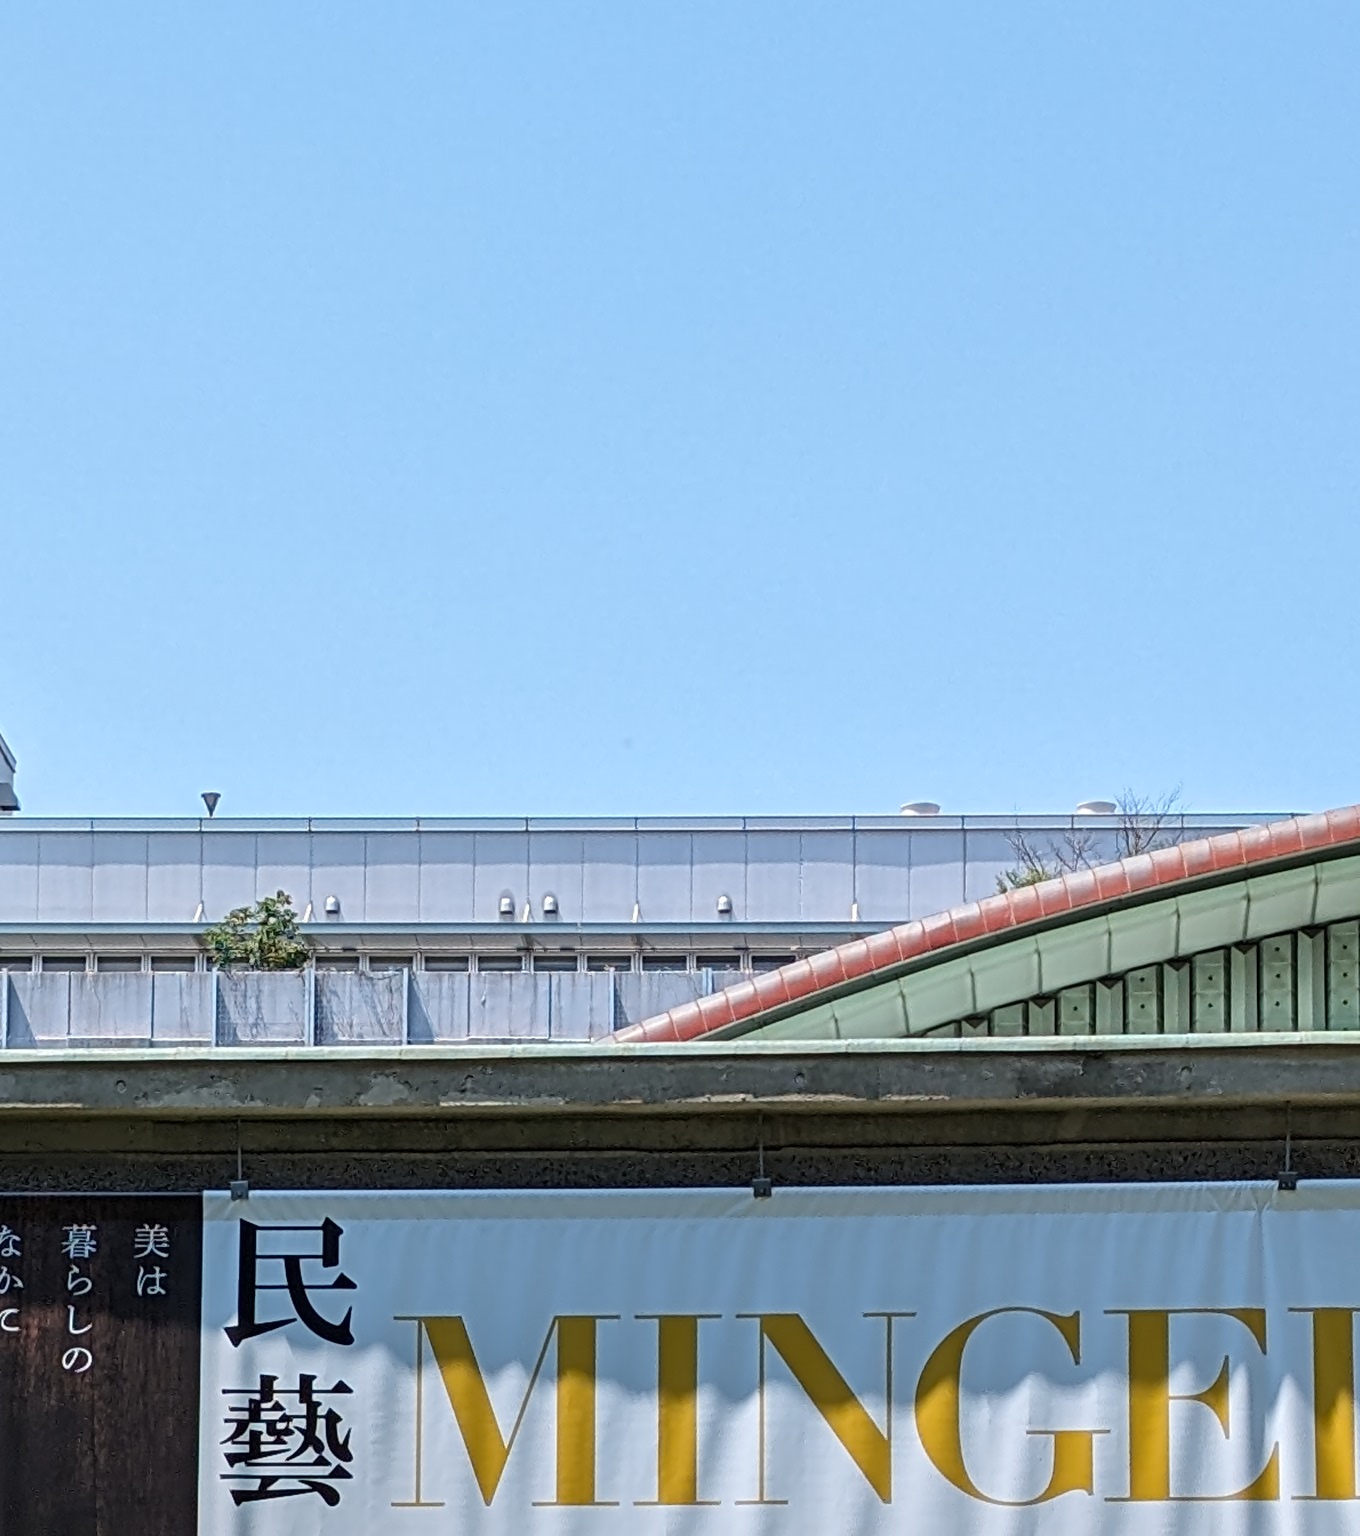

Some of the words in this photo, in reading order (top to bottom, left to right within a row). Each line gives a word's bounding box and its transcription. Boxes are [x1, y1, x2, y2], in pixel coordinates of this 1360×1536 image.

[61, 1224, 97, 1374] 暮らしの
[134, 1223, 170, 1297] 美は
[220, 1216, 358, 1508] 民藝
